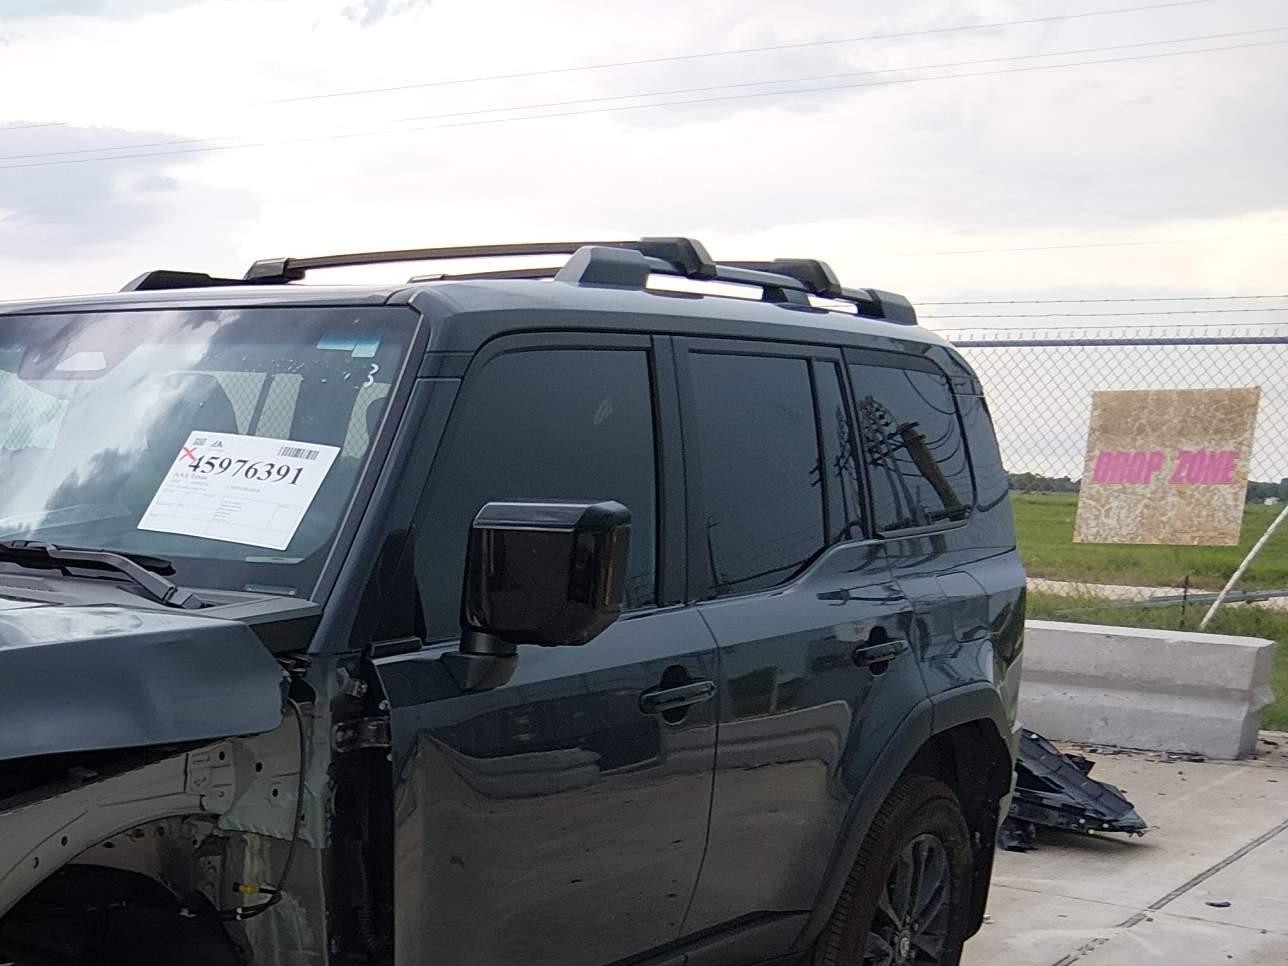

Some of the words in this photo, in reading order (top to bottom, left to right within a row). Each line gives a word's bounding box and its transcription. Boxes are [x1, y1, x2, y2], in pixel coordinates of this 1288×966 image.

[188, 455, 304, 485] 45976391
[1091, 450, 1165, 485] DROP
[1169, 448, 1240, 485] ZONE
